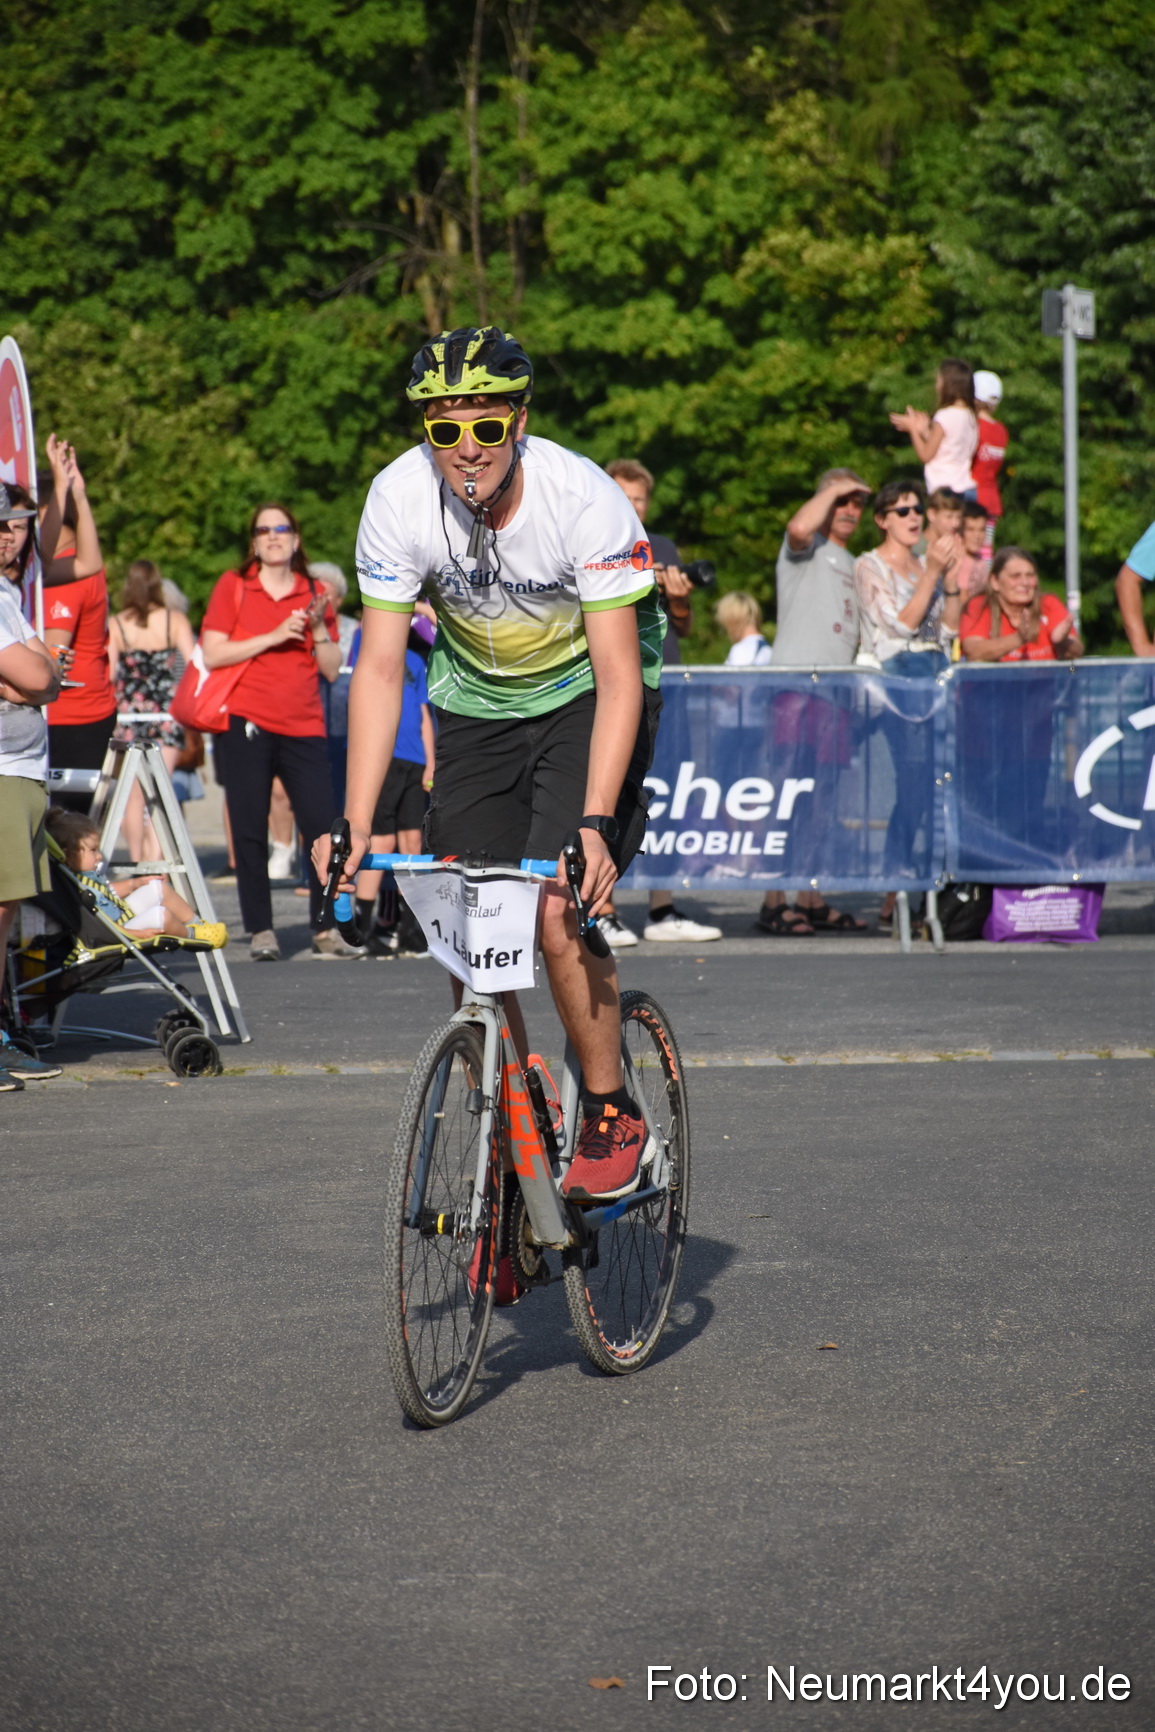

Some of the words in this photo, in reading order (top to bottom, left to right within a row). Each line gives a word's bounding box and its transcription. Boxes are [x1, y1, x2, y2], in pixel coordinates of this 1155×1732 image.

[602, 549, 632, 563] SCHNEE
[583, 560, 631, 571] PFERDCHEN
[431, 918, 448, 944] 1.
[453, 930, 523, 970] Läufer
